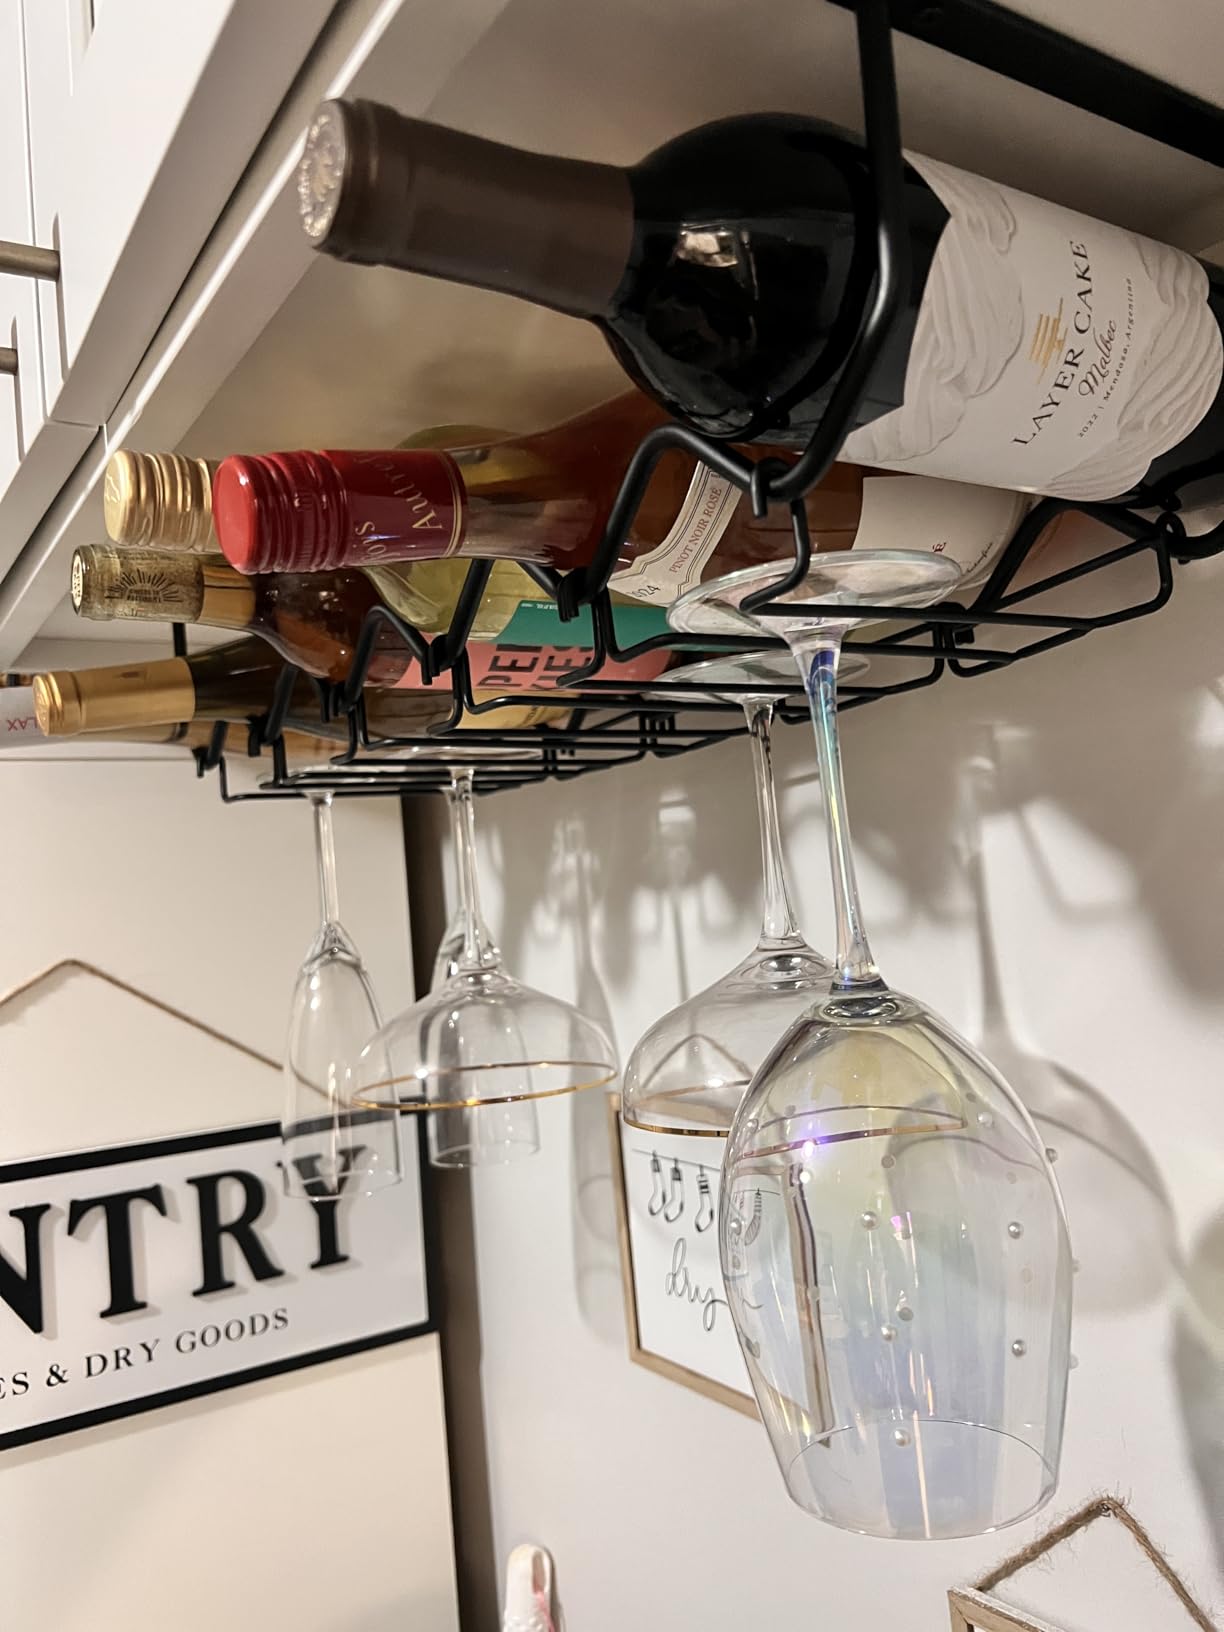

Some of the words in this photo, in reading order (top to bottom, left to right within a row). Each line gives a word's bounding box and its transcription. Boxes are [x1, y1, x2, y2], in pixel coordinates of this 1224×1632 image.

[1010, 347, 1085, 446] LAYER
[1069, 239, 1094, 336] CAKE
[1077, 413, 1099, 438] 2022
[1124, 277, 1134, 341] Argentina
[1077, 319, 1117, 397] Malbec
[668, 545, 694, 574] PINOT
[688, 518, 710, 546] NOIR
[46, 1363, 69, 1388] &
[85, 1338, 161, 1379] DRY
[175, 1308, 290, 1355] GOODS
